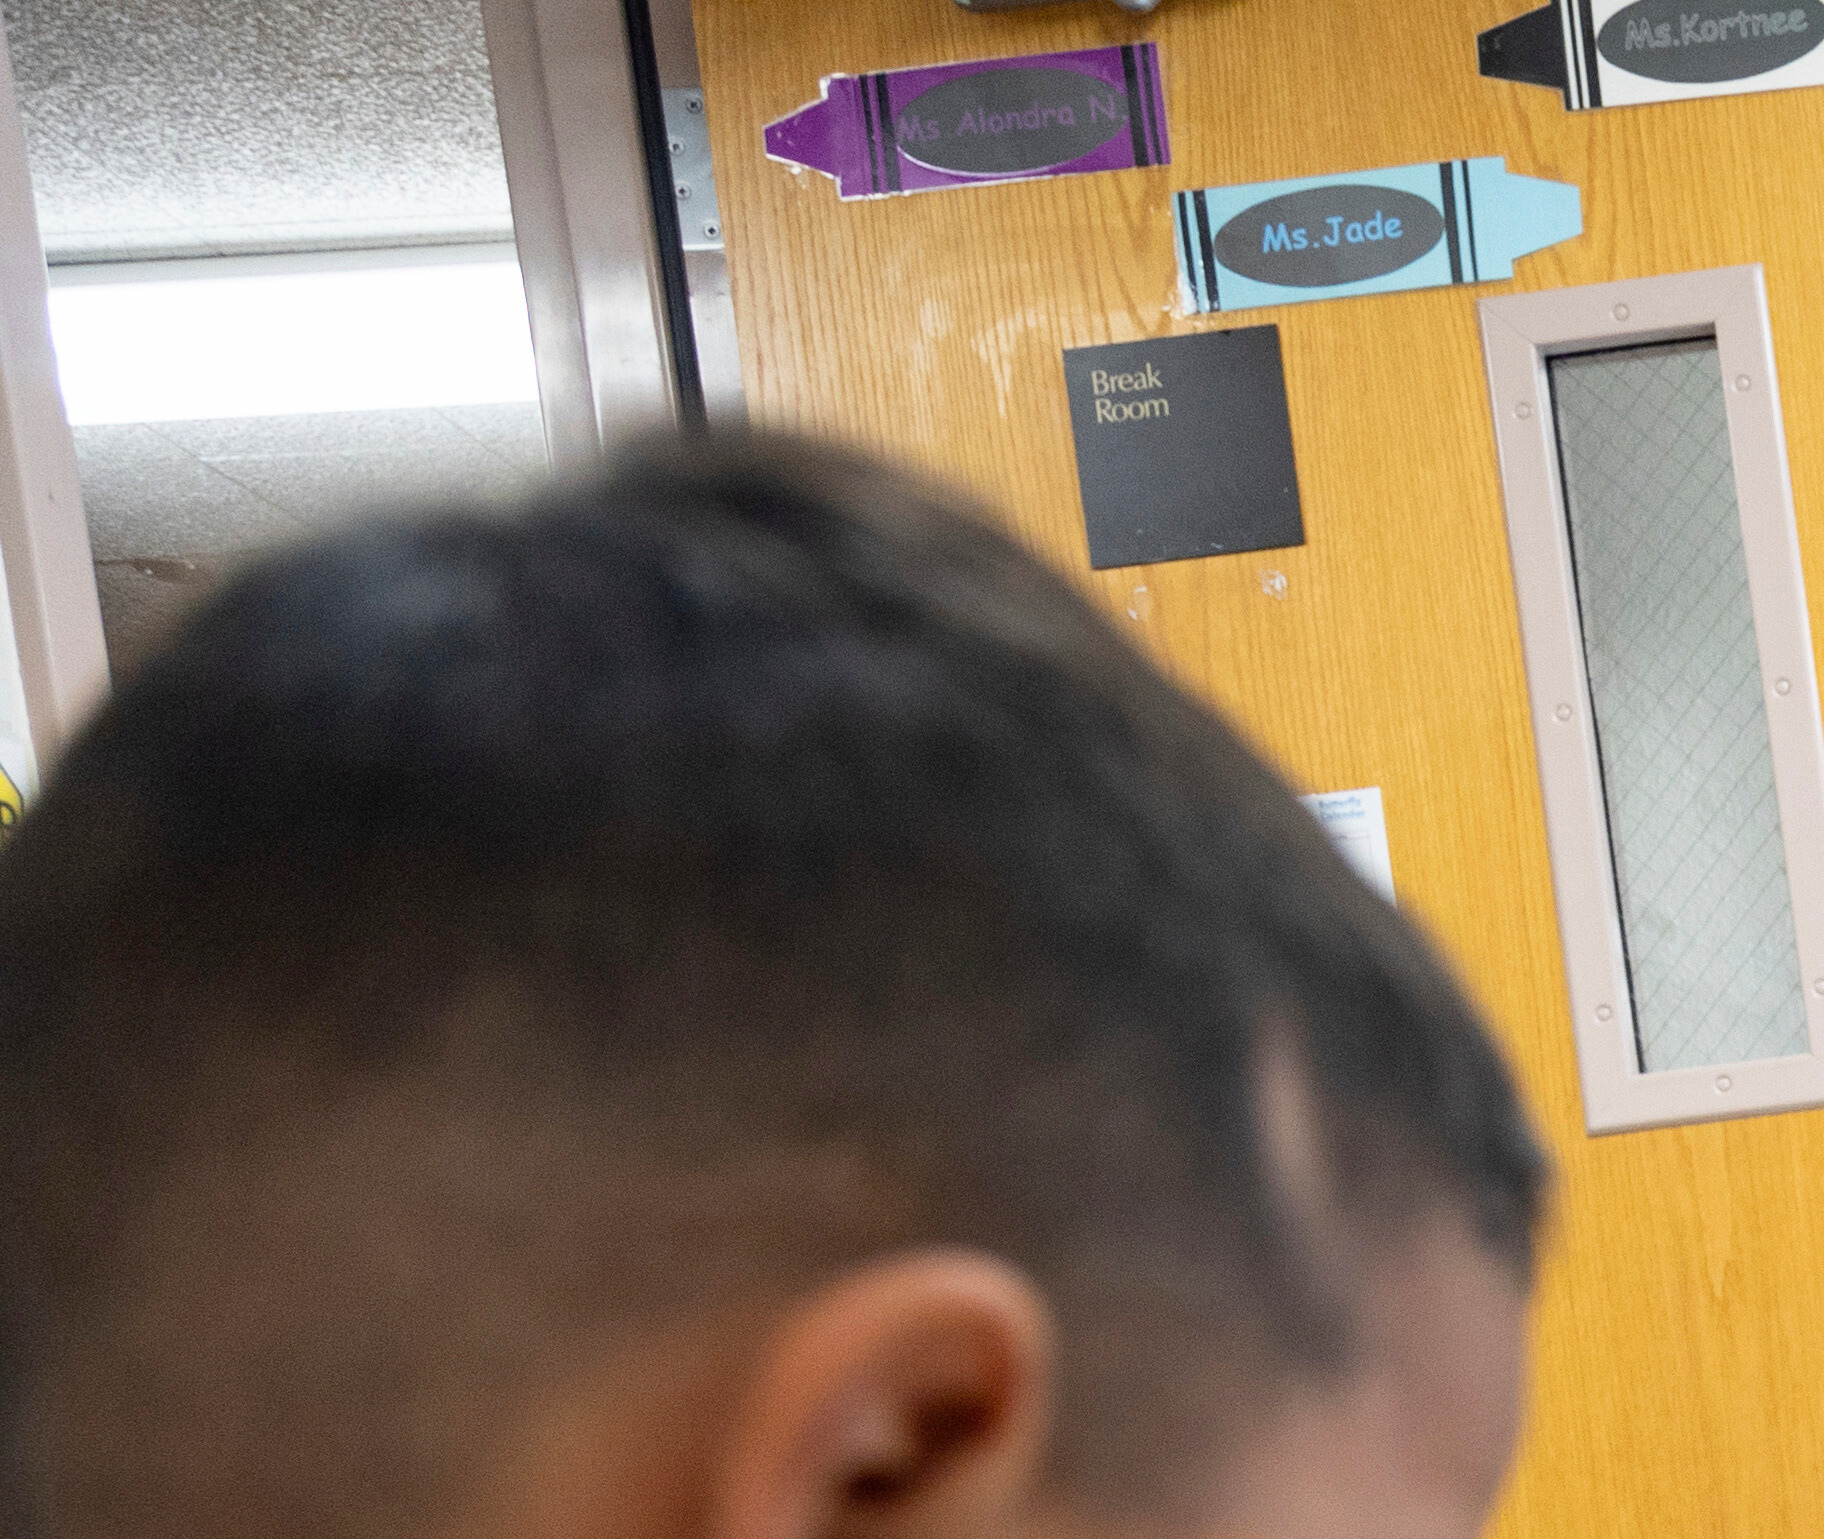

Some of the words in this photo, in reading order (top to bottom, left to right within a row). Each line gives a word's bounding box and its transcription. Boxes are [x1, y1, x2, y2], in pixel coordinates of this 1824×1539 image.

[1261, 209, 1404, 254] Ms.Jade
[1091, 361, 1163, 397] Break
[1095, 398, 1170, 424] Room
